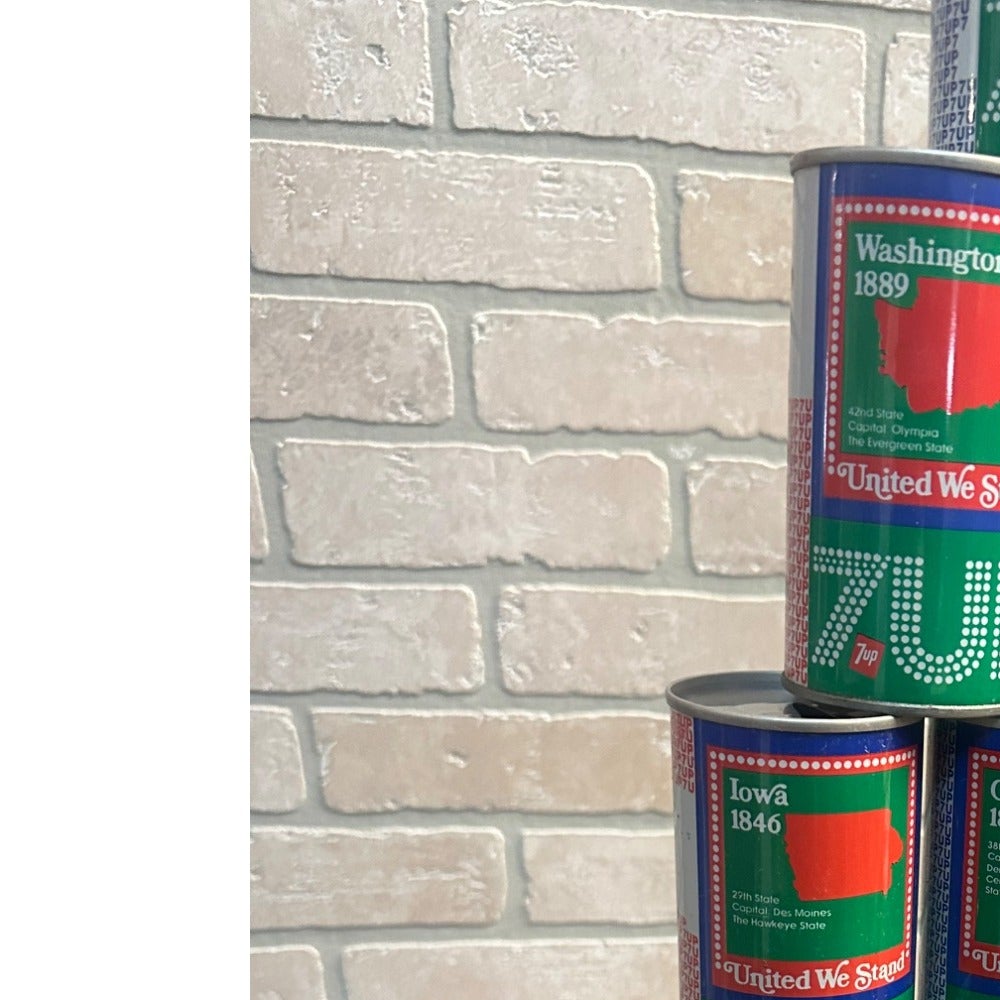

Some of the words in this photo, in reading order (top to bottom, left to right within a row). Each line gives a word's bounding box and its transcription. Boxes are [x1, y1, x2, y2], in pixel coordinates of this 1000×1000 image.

[854, 270, 910, 298] 1889
[848, 407, 870, 419] 42nd
[871, 409, 904, 421] State
[891, 424, 939, 439] Olympia
[848, 435, 865, 447] The
[867, 437, 923, 453] Evergreen
[925, 440, 954, 454] State
[837, 462, 932, 500] United
[937, 464, 976, 499] We
[854, 643, 879, 667] 7up
[729, 777, 789, 807] Iowa
[730, 809, 782, 834] 1846
[732, 890, 752, 903] 29th
[754, 892, 780, 905] State
[732, 914, 749, 926] The
[751, 916, 797, 930] Hawkeye
[799, 919, 827, 930] State
[774, 906, 792, 918] Des
[794, 908, 832, 918] Moines
[722, 960, 811, 995] United
[815, 960, 850, 989] We
[854, 952, 906, 991] Stand
